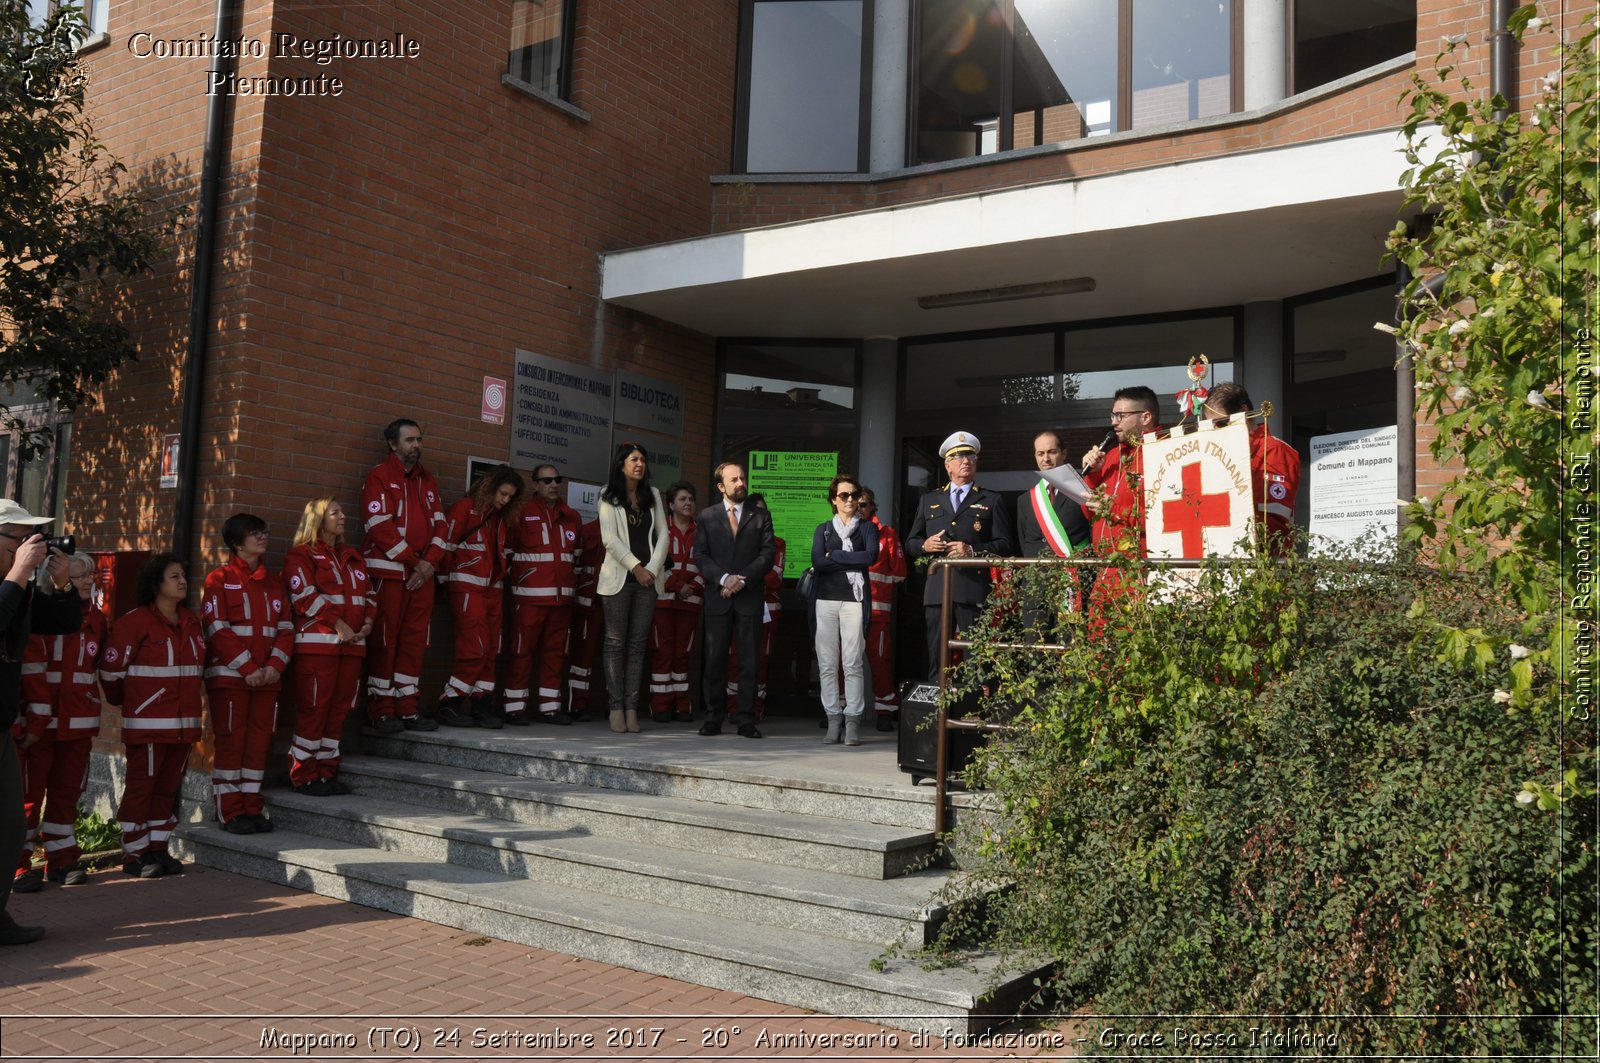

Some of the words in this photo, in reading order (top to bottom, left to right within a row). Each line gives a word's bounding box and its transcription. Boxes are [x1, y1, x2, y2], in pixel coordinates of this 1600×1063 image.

[517, 361, 546, 381] CONSORZIO
[620, 381, 680, 412] BIBLIOTECA
[551, 406, 558, 416] DI
[559, 409, 610, 428] AMMINISTRAZIONE
[543, 420, 591, 438] AMMINISTRATIVO
[543, 433, 569, 447] TECNICO
[1313, 441, 1336, 450] ELEZIONE
[1374, 434, 1397, 442] SINDACO
[516, 449, 547, 461] SECONDO
[548, 455, 568, 464] PIANO
[1333, 444, 1361, 453] CONSIGLIO
[1317, 462, 1346, 471] Comune
[1347, 459, 1355, 468] di
[1357, 456, 1393, 467] Mappano
[1146, 462, 1167, 509] CROCE
[1165, 439, 1200, 467] ROSSA
[1204, 440, 1249, 496] ITALIANA
[1314, 512, 1345, 520] FRANCESCO
[1346, 510, 1374, 518] AUGUSTO
[1375, 508, 1396, 516] GRASSI
